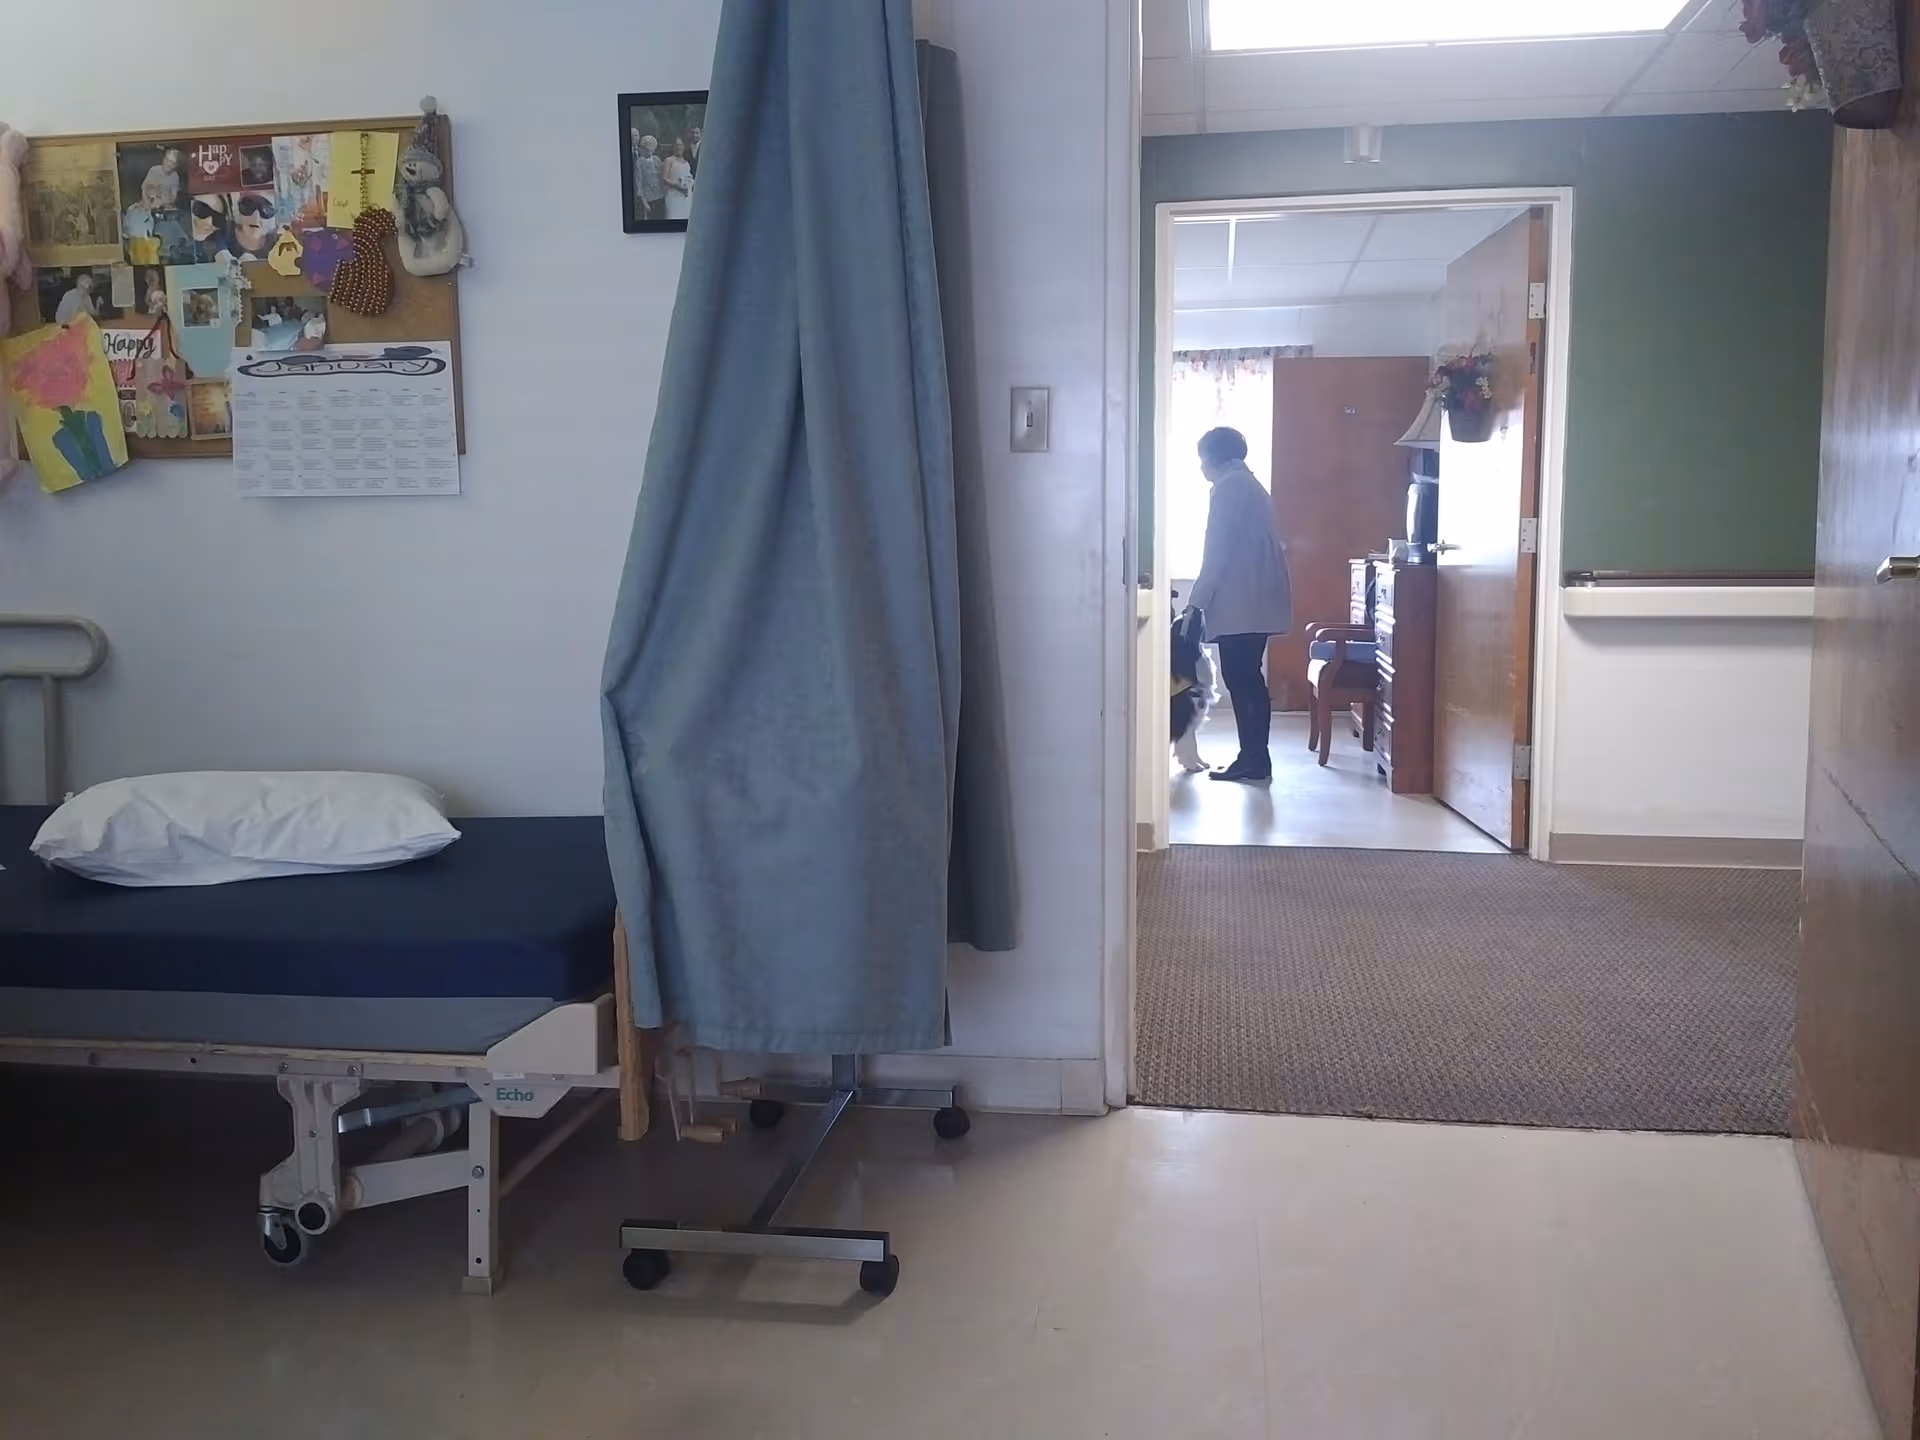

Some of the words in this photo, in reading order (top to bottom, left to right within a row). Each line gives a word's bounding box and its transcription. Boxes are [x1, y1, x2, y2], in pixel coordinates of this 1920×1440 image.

[103, 332, 157, 360] Happy
[256, 360, 430, 373] January
[496, 1088, 534, 1101] Echo
